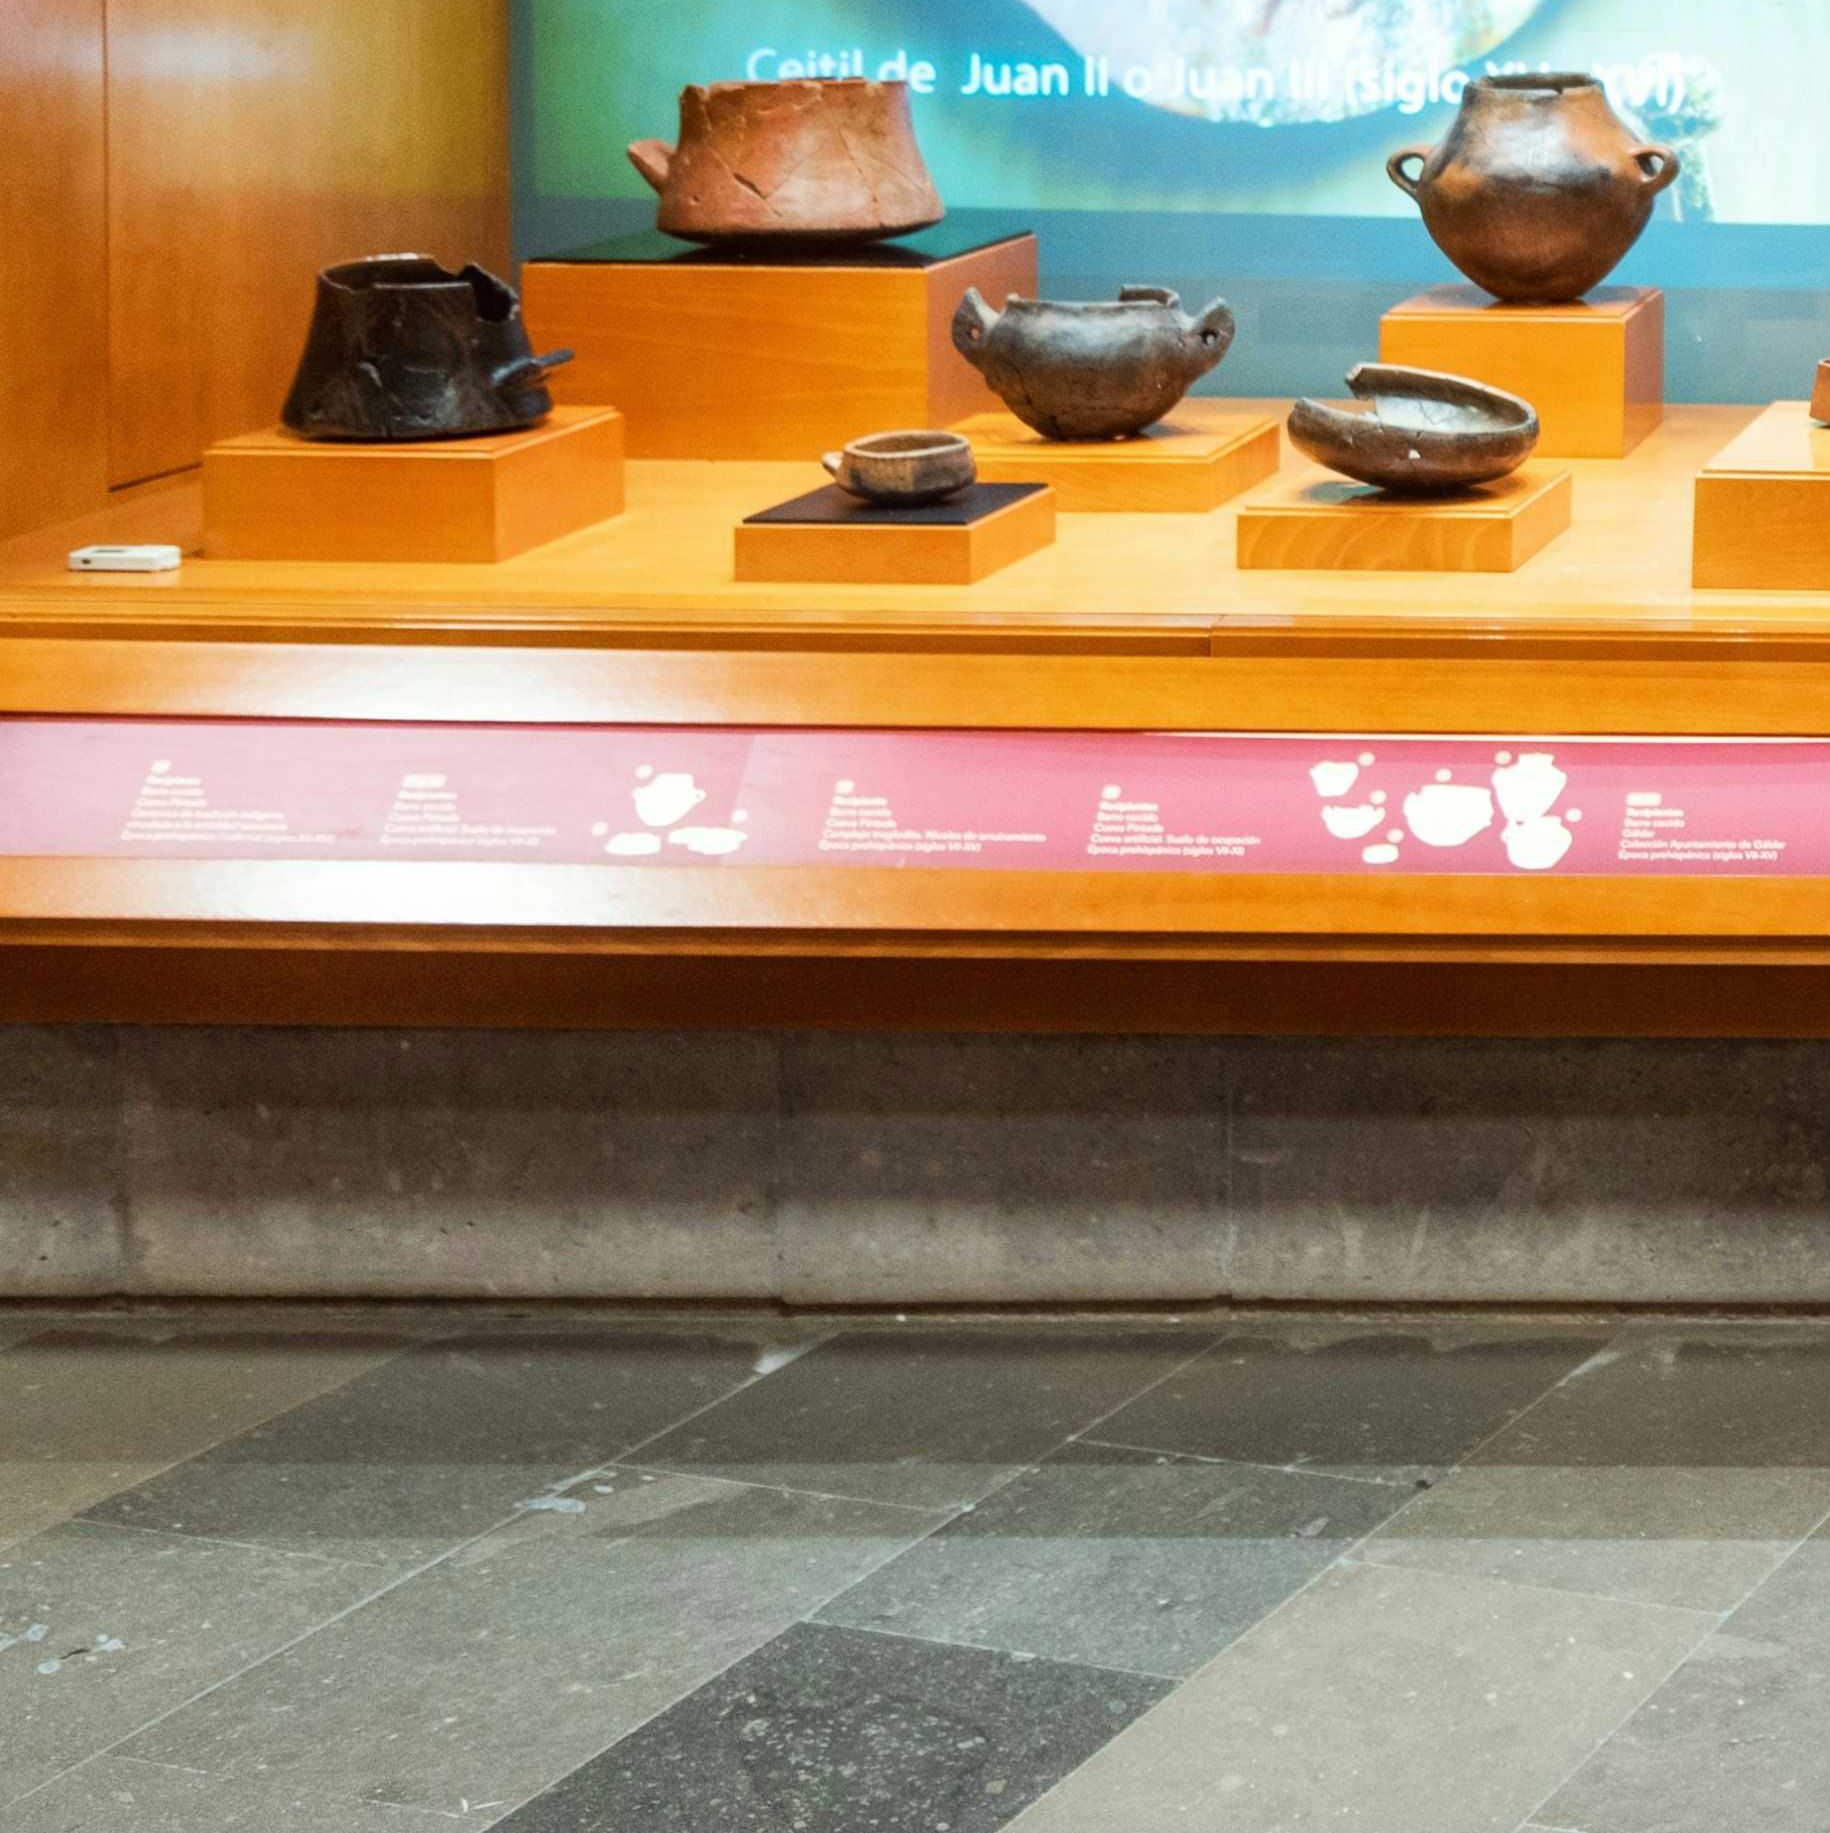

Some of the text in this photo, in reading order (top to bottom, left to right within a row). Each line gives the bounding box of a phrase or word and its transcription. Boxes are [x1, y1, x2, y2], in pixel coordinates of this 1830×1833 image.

[746, 49, 863, 80] Ceitil
[877, 50, 936, 94] de
[960, 53, 1068, 96] Juan
[1124, 66, 1151, 97] o
[1162, 57, 1275, 100] Juan
[1346, 60, 1470, 114] (siglo
